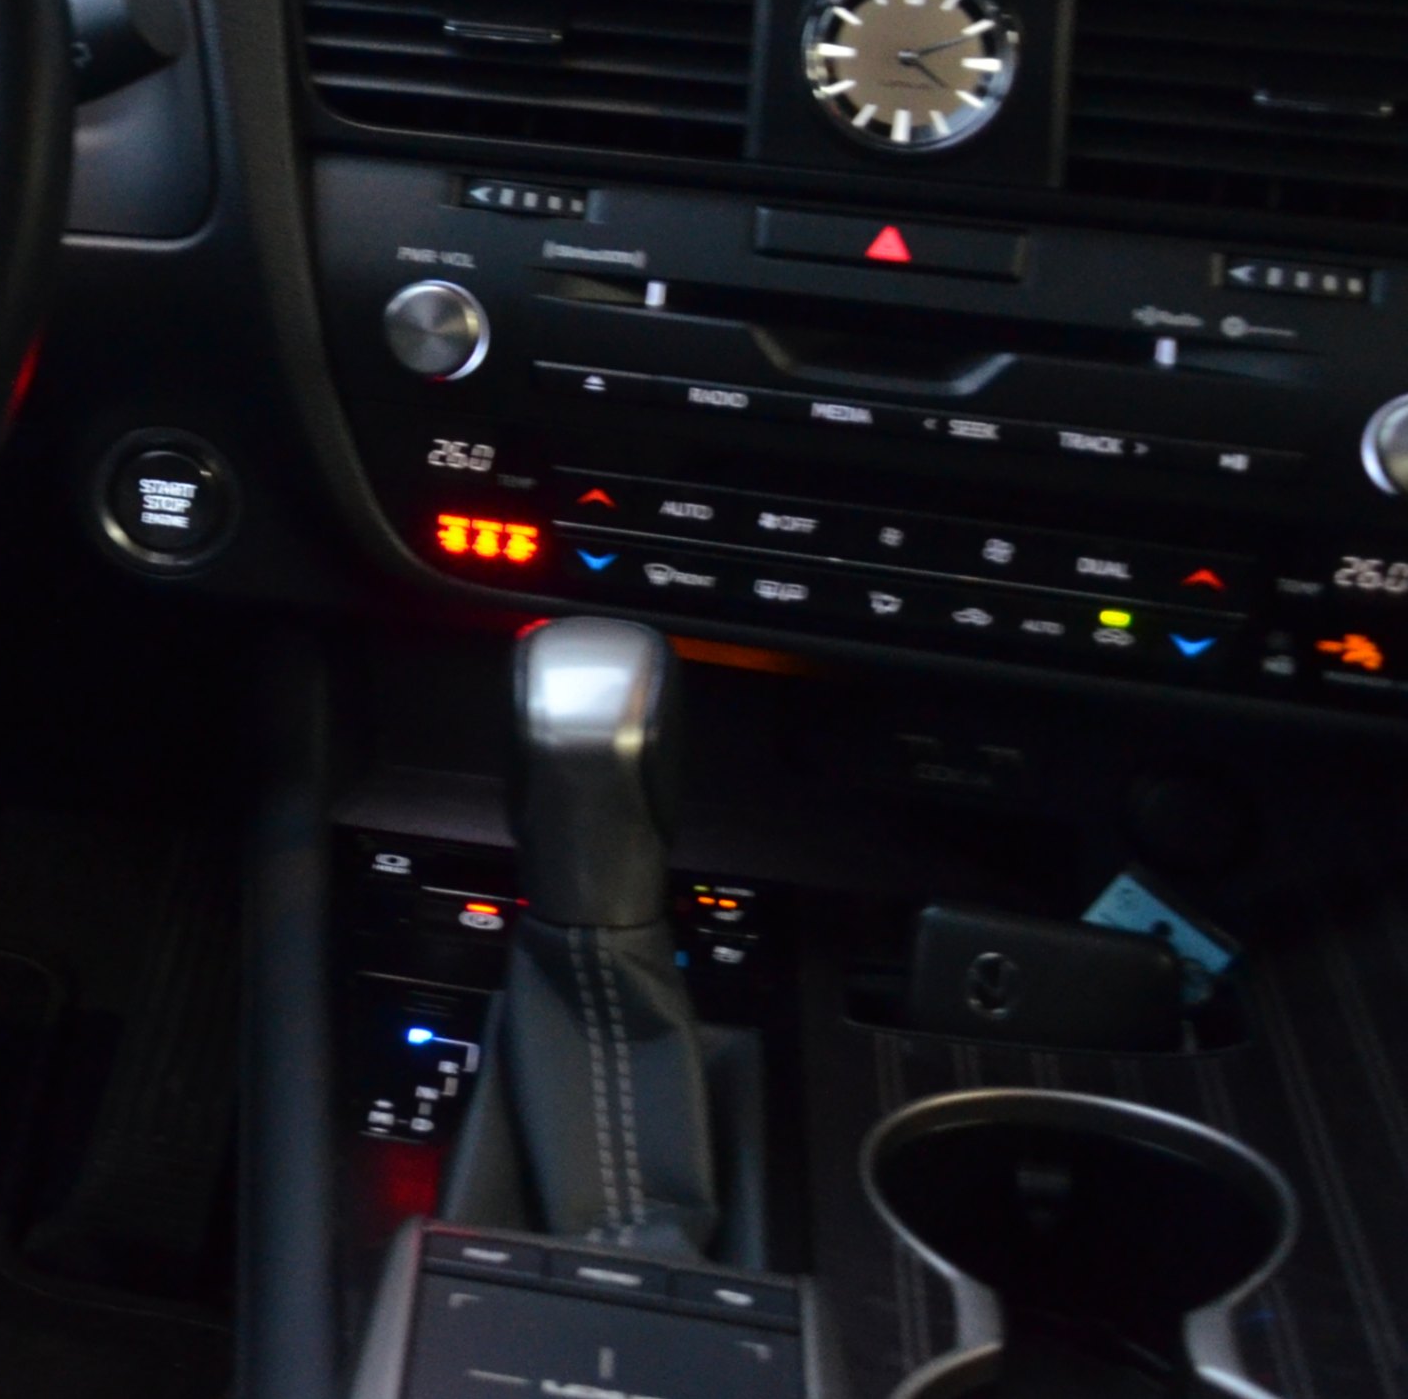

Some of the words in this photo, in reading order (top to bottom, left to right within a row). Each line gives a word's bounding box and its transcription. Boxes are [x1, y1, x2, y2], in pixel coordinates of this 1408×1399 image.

[688, 387, 749, 409] RADIO
[811, 403, 873, 424] MEDIA
[948, 419, 1000, 440] SEEK
[1059, 431, 1123, 454] TRACK
[138, 478, 198, 498] START
[142, 494, 191, 513] STOP
[659, 501, 714, 520] AUTO
[778, 515, 820, 534] OFF
[1076, 556, 1132, 579] DUAL
